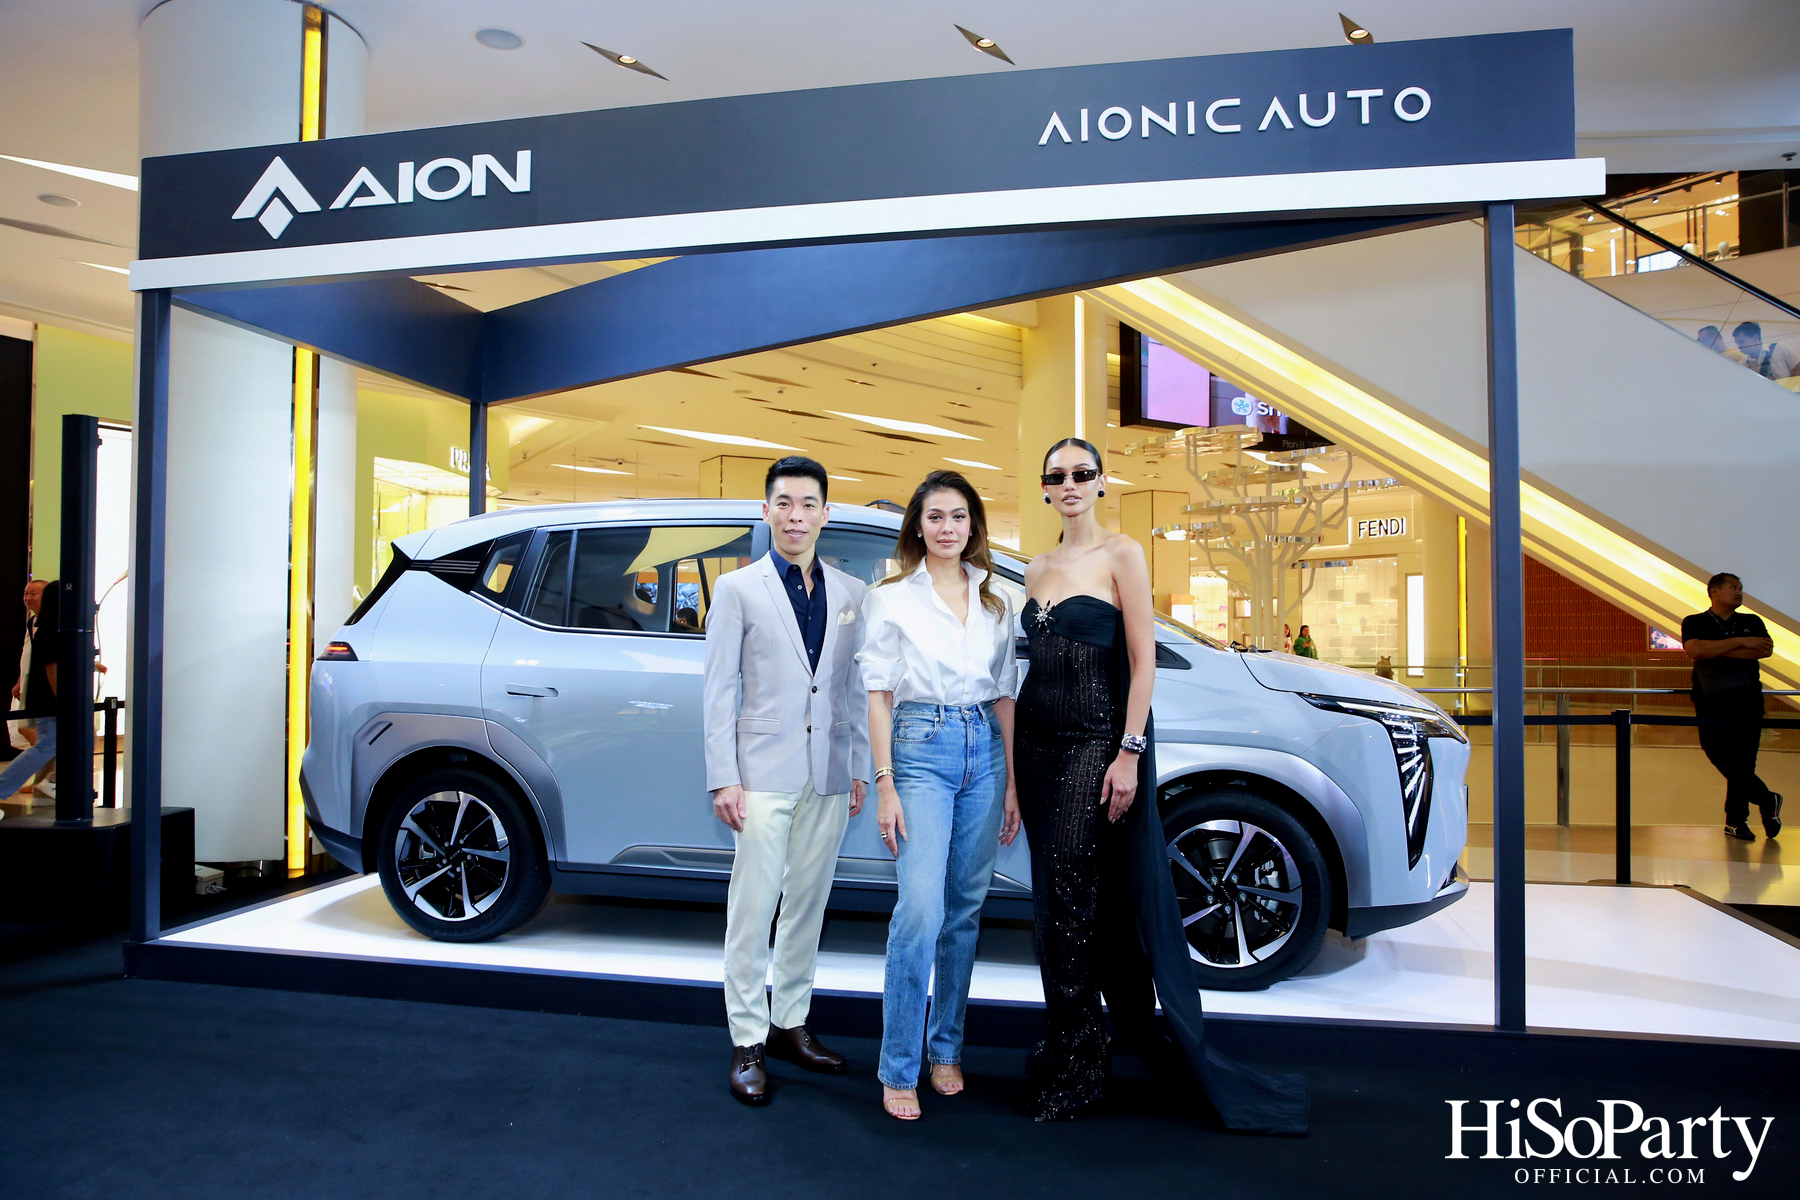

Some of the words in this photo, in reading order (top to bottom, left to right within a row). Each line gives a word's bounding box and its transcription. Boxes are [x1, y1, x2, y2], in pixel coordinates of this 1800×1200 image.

[1038, 98, 1241, 146] AIONIC
[1258, 86, 1432, 132] AUTO
[329, 150, 531, 210] AION
[1358, 517, 1405, 538] FENDI
